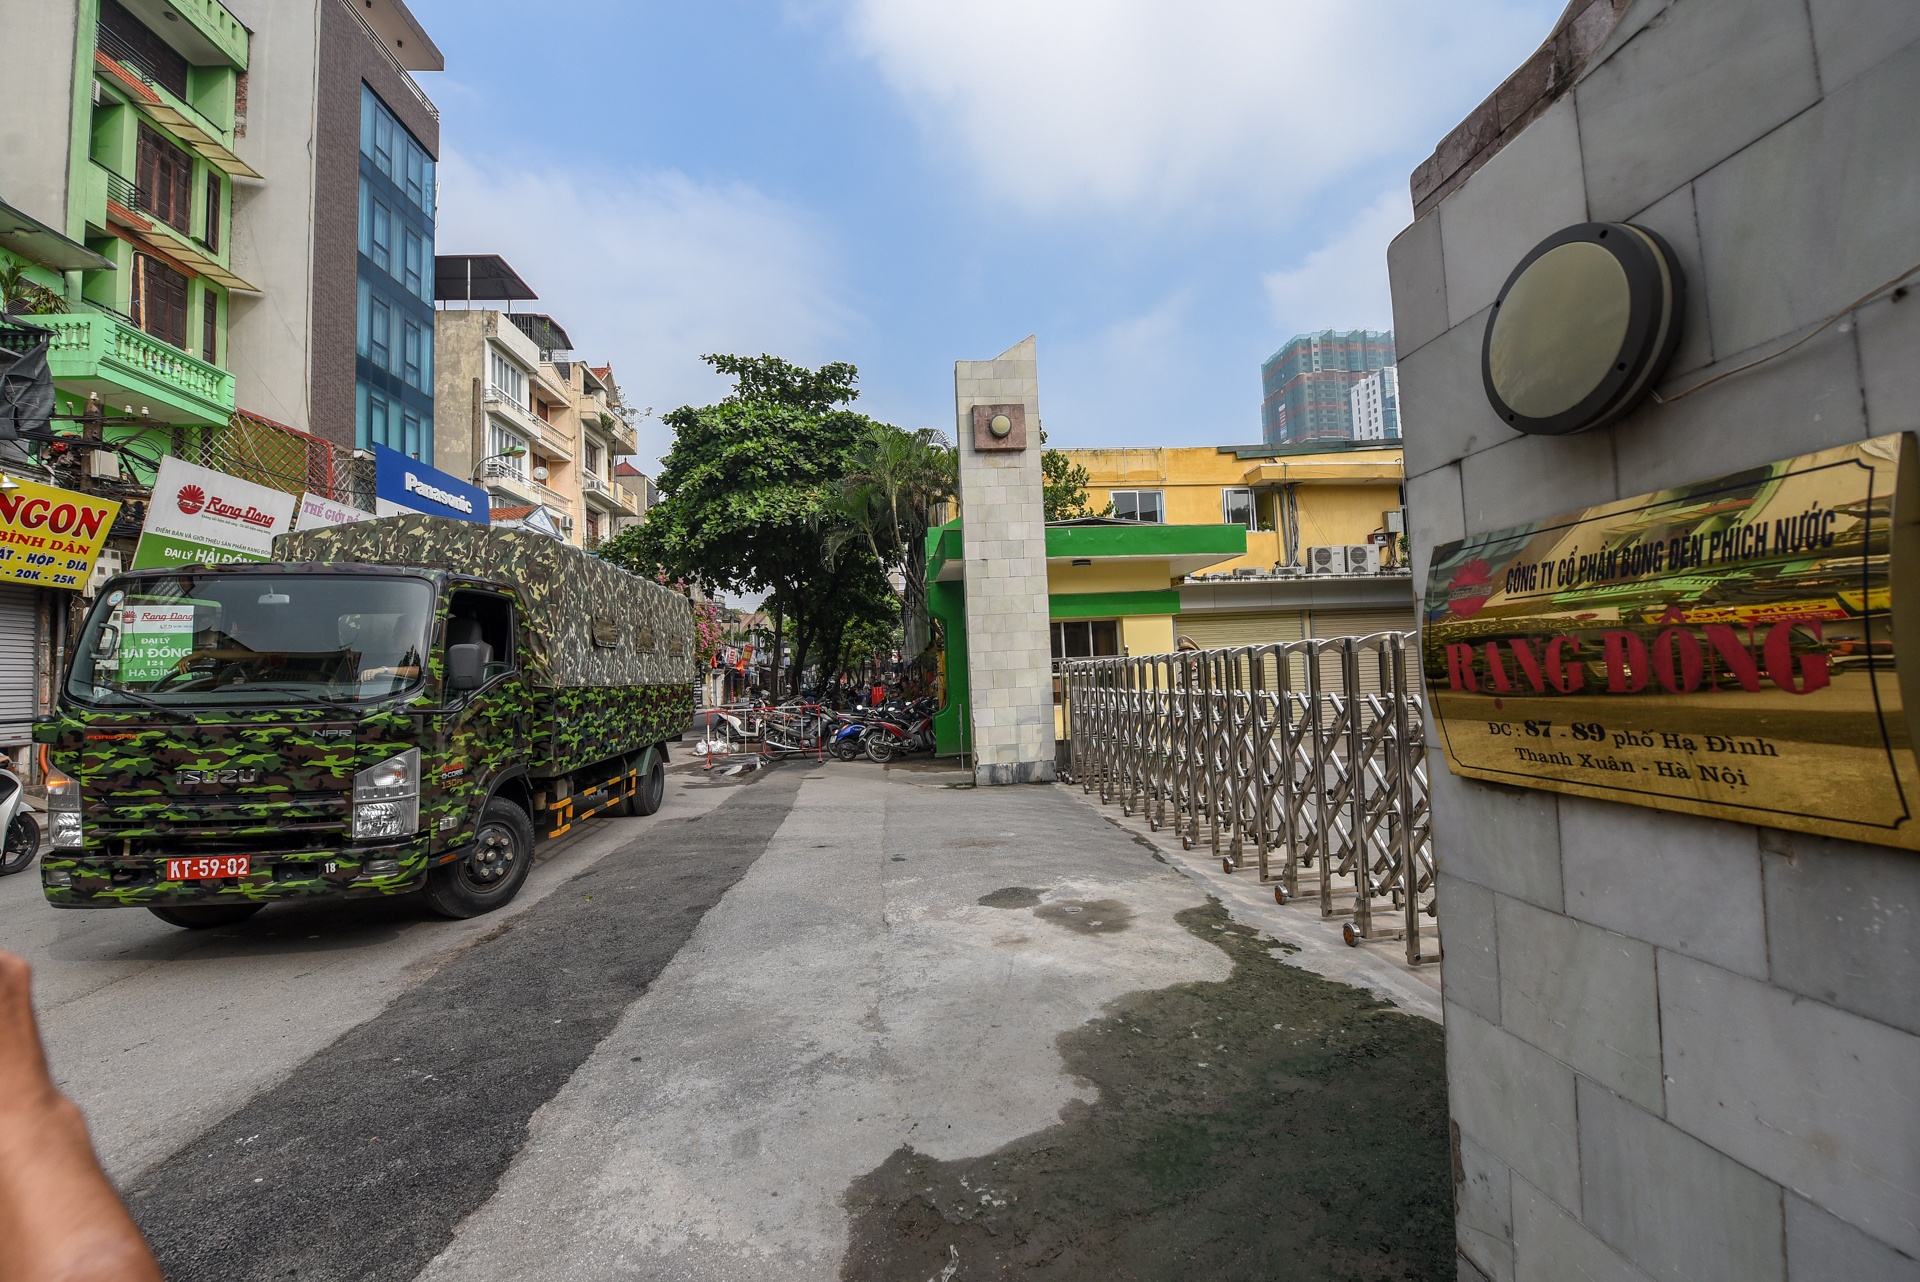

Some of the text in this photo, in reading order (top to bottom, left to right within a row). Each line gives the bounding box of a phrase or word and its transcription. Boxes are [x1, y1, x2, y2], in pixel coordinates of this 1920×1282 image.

[405, 471, 473, 515] Panasonic
[304, 501, 326, 517] THẾ
[325, 509, 346, 524] GIỚI
[49, 540, 91, 555] DÂN
[164, 547, 181, 560] ĐẠI
[182, 550, 194, 560] LÝ
[195, 547, 220, 563] HẢI
[1505, 501, 1836, 595] CÔNG TY CỔ PHẦN BÓNG ĐÈN PHÍCH NƯỚC
[26, 552, 55, 568] HỘP
[15, 569, 41, 580] 20K
[52, 574, 77, 584] 25K
[141, 637, 158, 645] ĐẠI
[1445, 605, 1832, 710] RẠNG ĐÔNG
[129, 668, 147, 678] HẠ
[312, 729, 352, 738] NPR
[1489, 721, 1512, 737] ĐC
[1524, 720, 1552, 738] 87
[1571, 722, 1606, 742] 89
[1612, 728, 1655, 749] phố
[1660, 733, 1697, 756] Hạ
[1704, 735, 1779, 757] Đình
[176, 768, 255, 785] ISUZU
[1515, 747, 1574, 767] Thanh
[1580, 753, 1636, 774] Xuân
[1656, 760, 1691, 780] Hà
[1699, 764, 1749, 790] Nội
[170, 857, 248, 879] KT-59-02
[324, 862, 336, 873] 18
